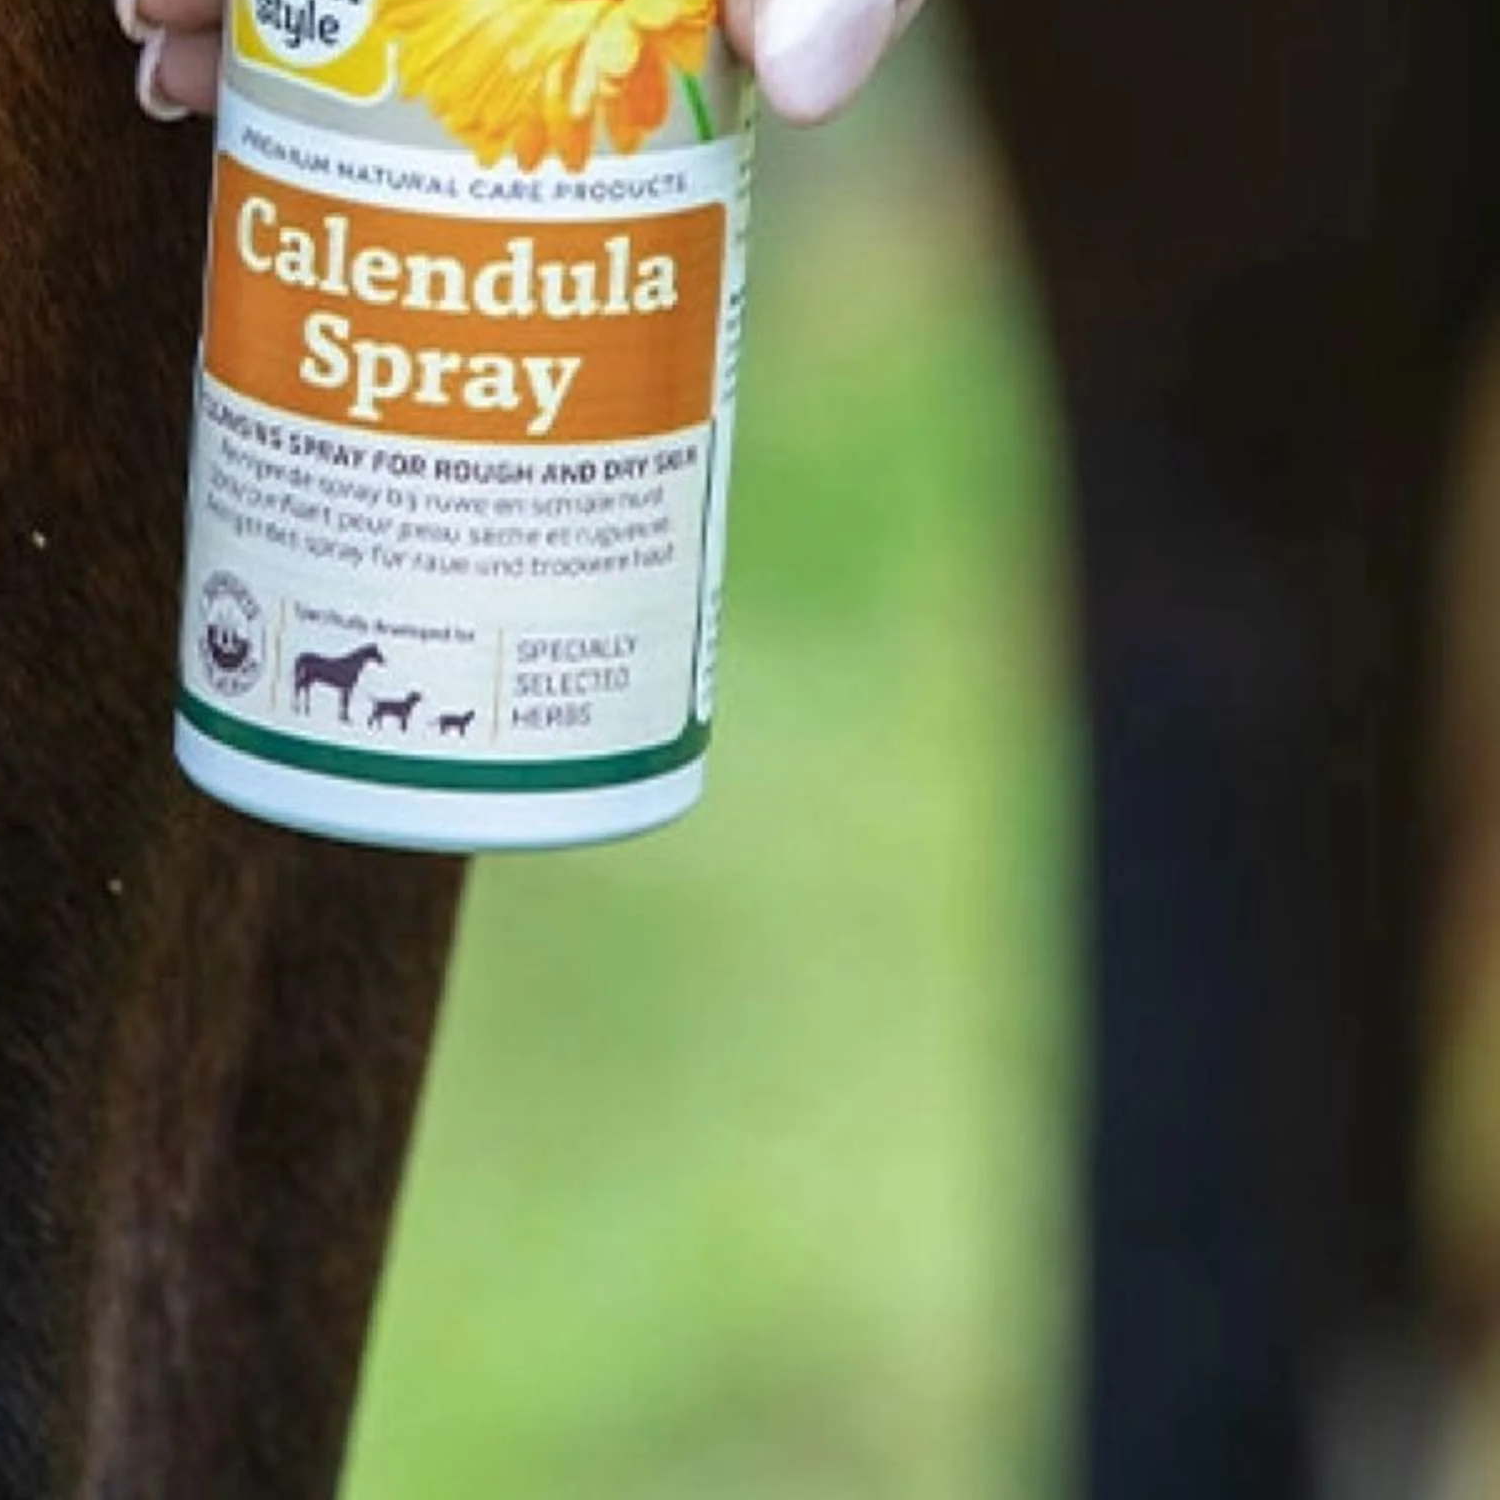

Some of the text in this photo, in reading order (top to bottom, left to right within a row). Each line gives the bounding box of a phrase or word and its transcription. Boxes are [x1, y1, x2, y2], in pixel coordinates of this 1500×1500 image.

[338, 160, 457, 197] NATURAL
[469, 177, 542, 201] CARE
[556, 171, 687, 202] PRODUCTS
[236, 196, 678, 318] Calendula
[299, 312, 582, 436] Spray
[289, 431, 365, 470] SPRAY
[371, 449, 426, 477] FOR
[434, 458, 534, 486] ROUGH
[541, 460, 597, 486] AND
[604, 456, 649, 482] DRY
[516, 634, 638, 663] SPECIALLY
[515, 667, 631, 697] SELECTED
[511, 701, 592, 729] HERBS
